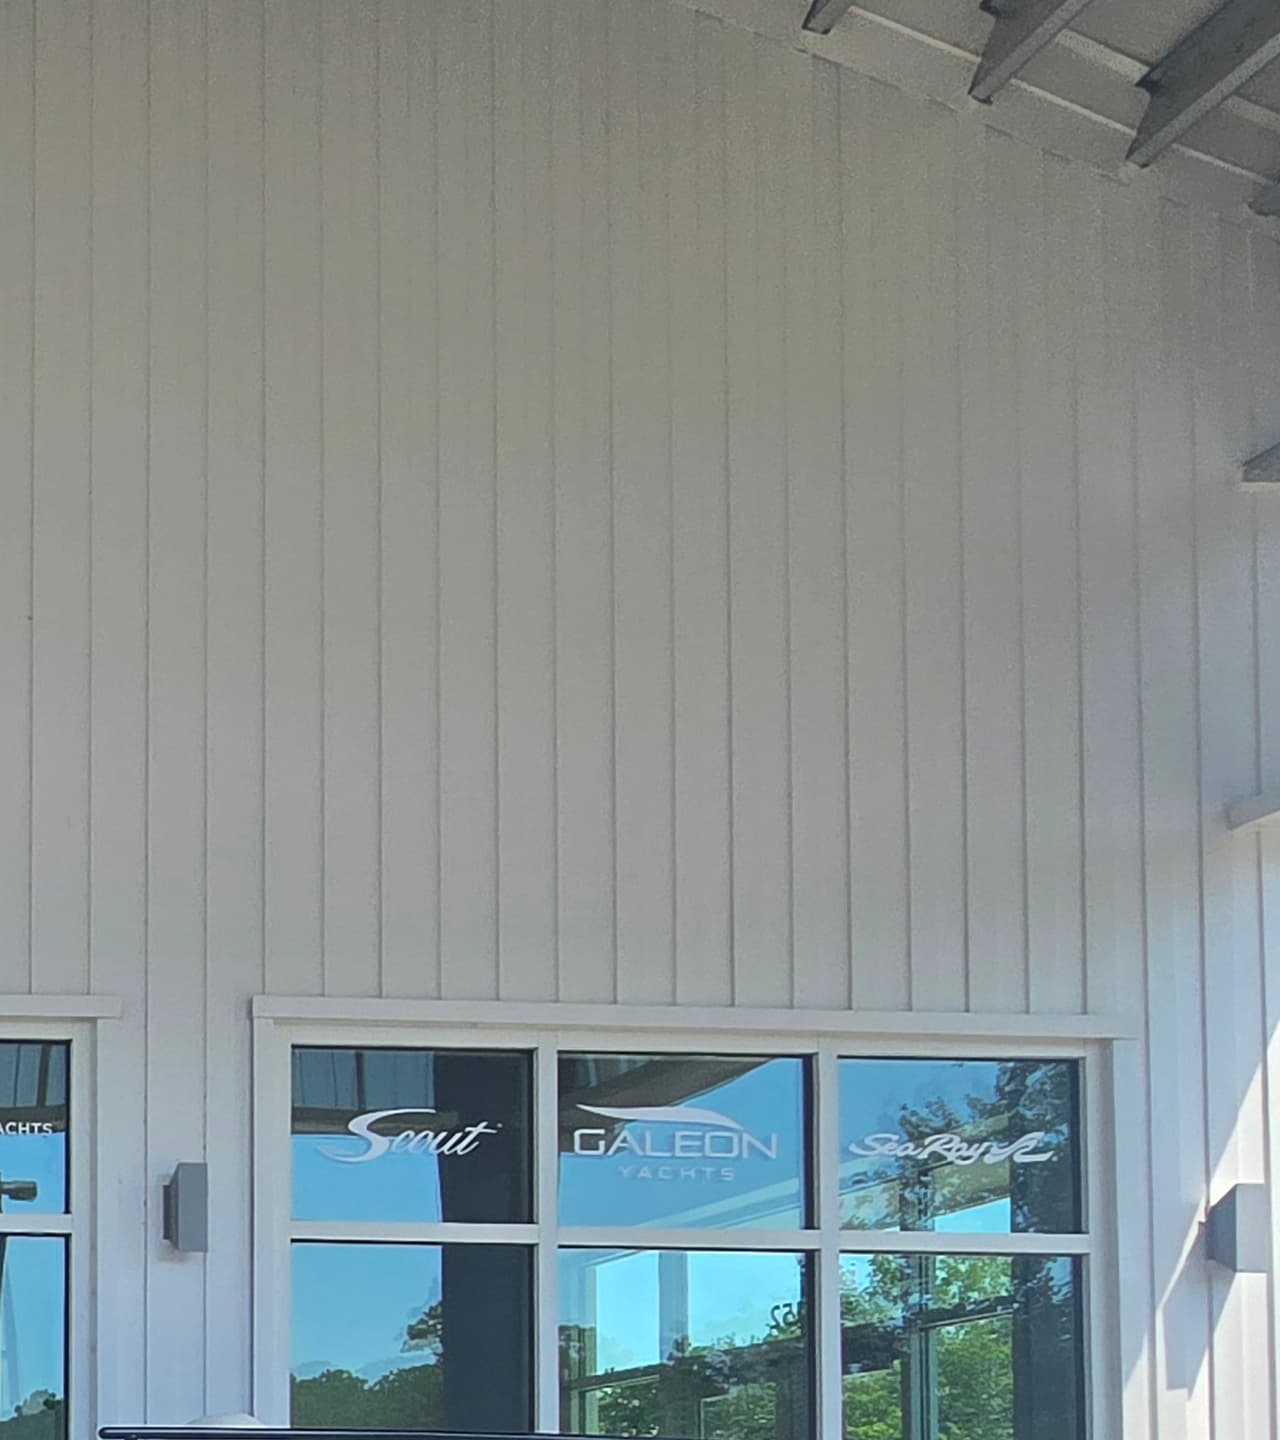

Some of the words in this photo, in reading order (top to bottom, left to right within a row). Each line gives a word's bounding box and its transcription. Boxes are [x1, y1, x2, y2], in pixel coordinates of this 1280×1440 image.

[316, 1107, 498, 1163] Scout
[573, 1128, 778, 1160] GALEON
[618, 1165, 735, 1182] YACHTS
